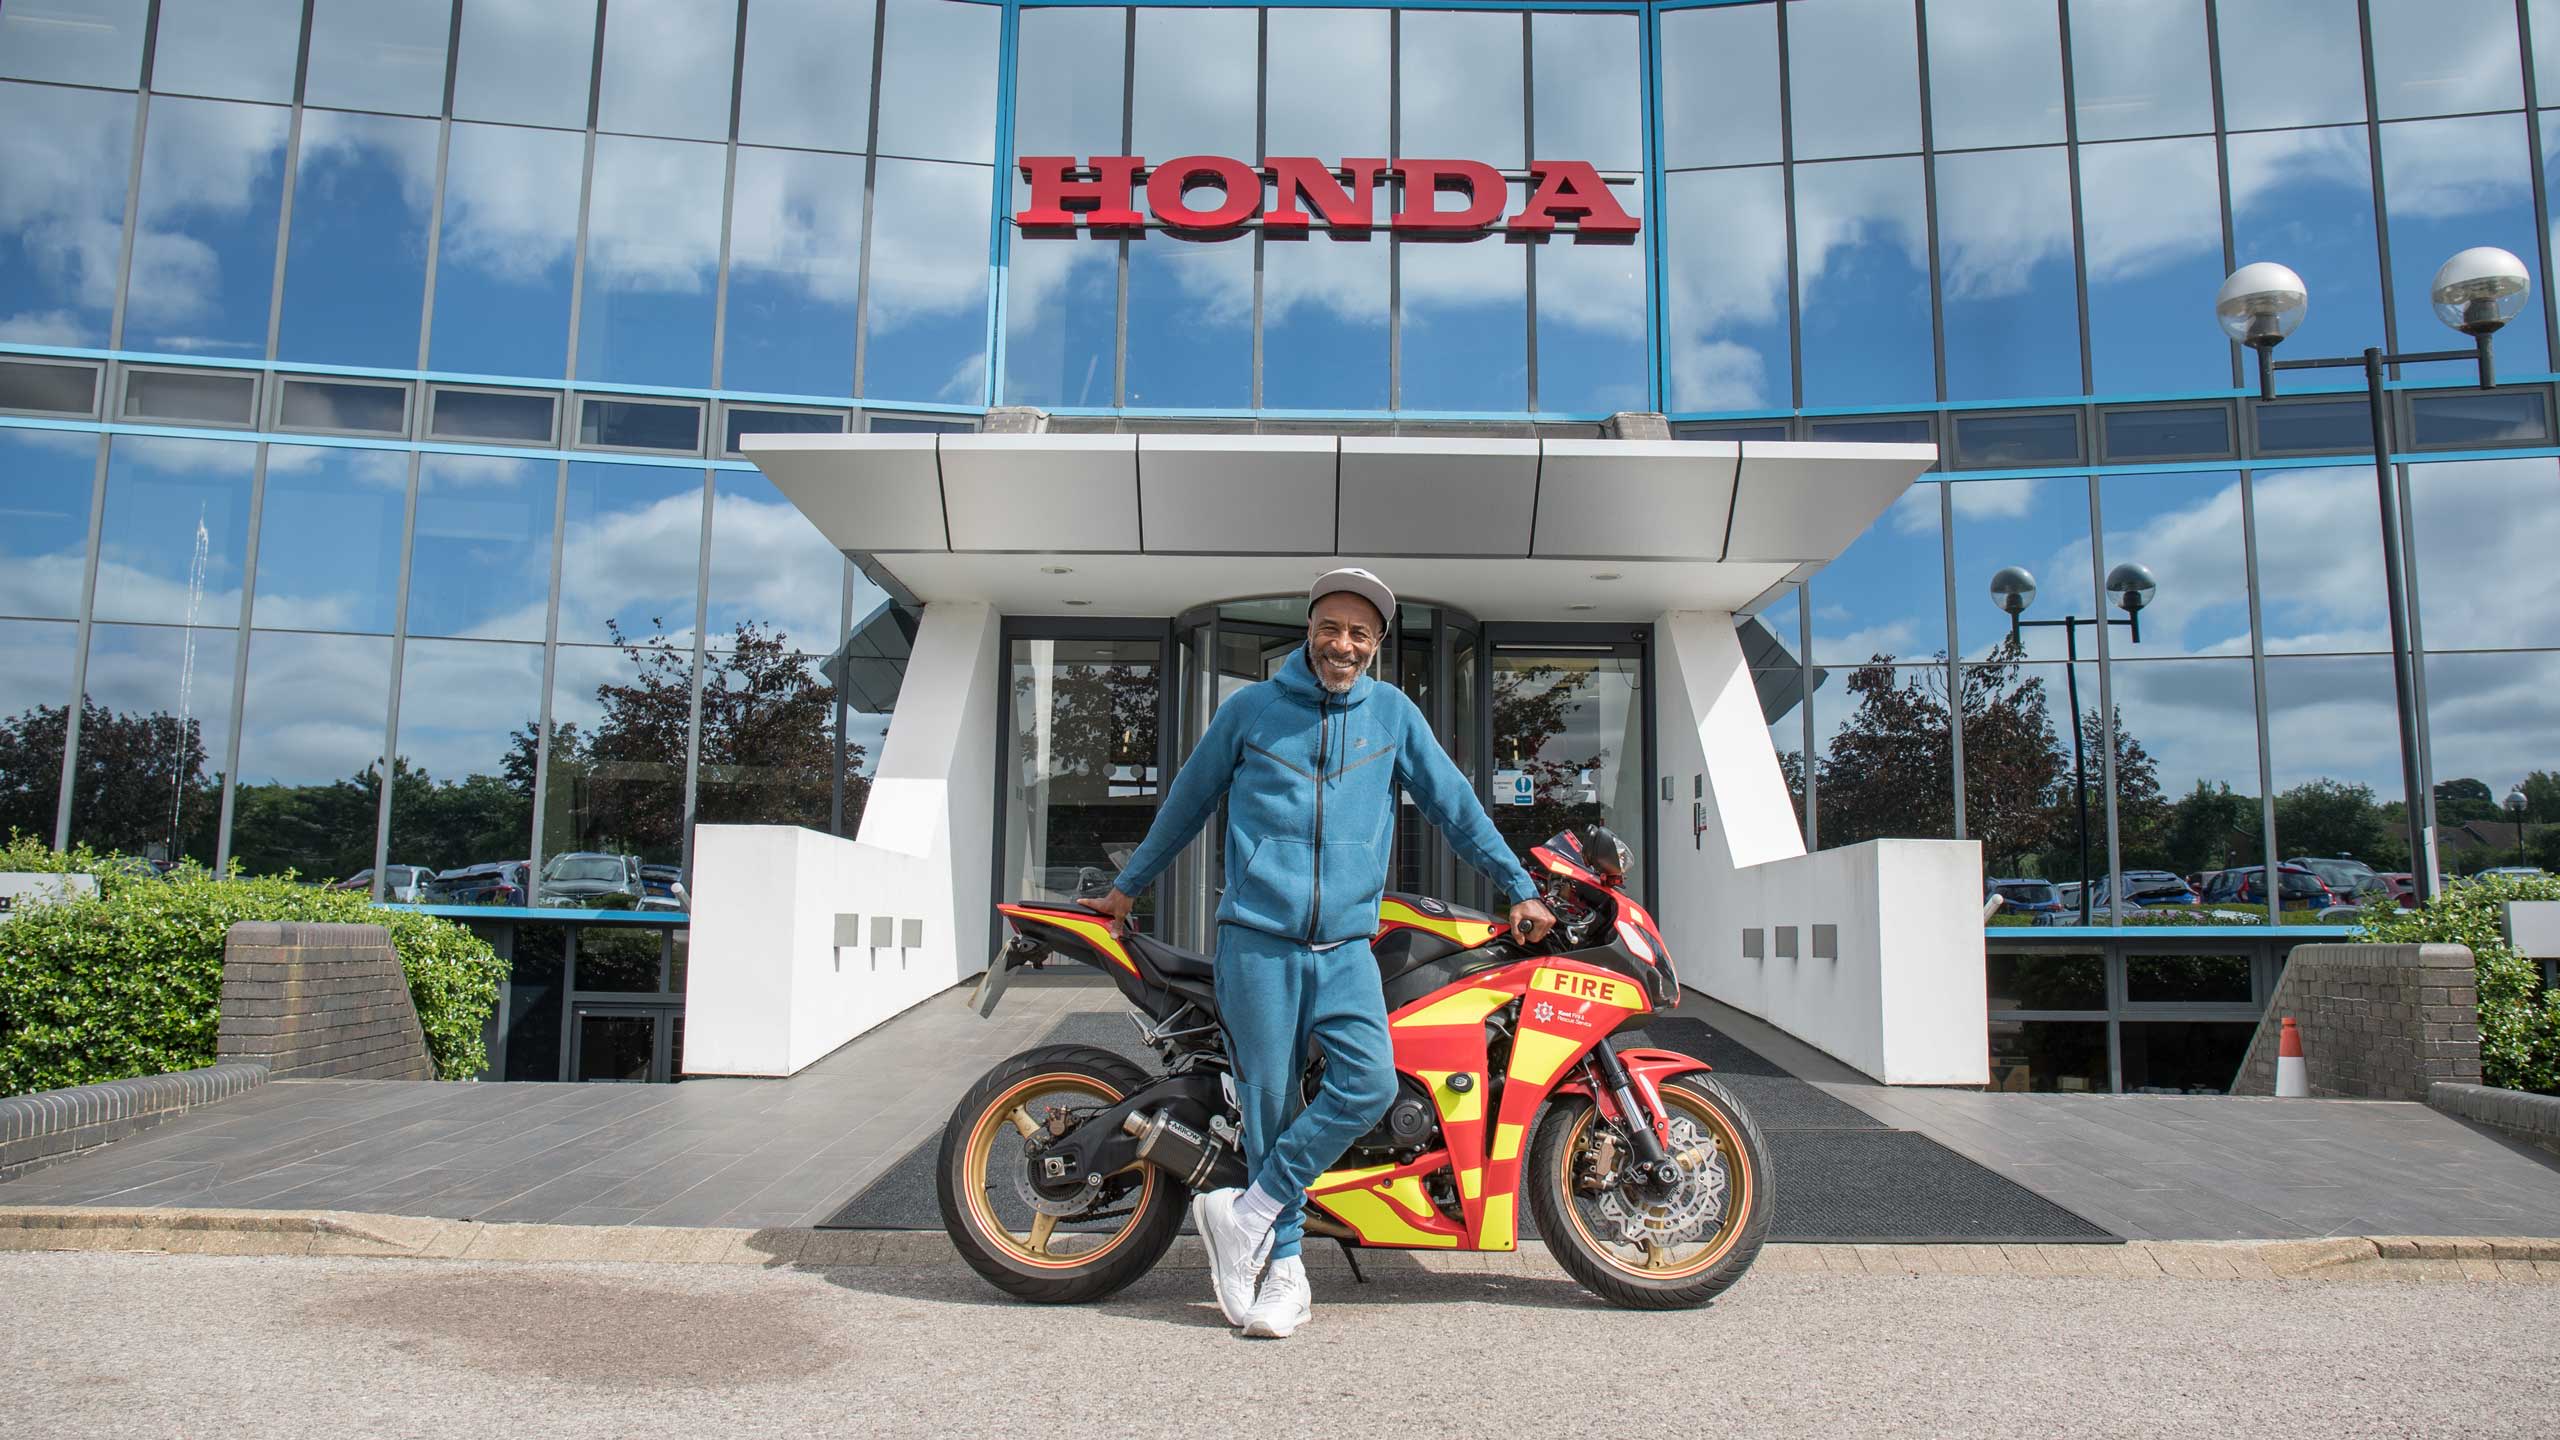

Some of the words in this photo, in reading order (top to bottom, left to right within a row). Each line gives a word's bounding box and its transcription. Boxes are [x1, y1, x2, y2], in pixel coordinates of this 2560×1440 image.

[1017, 155, 1641, 233] HONDA
[1554, 973, 1615, 1001] FIRE
[1171, 1122, 1200, 1141] ARROW
